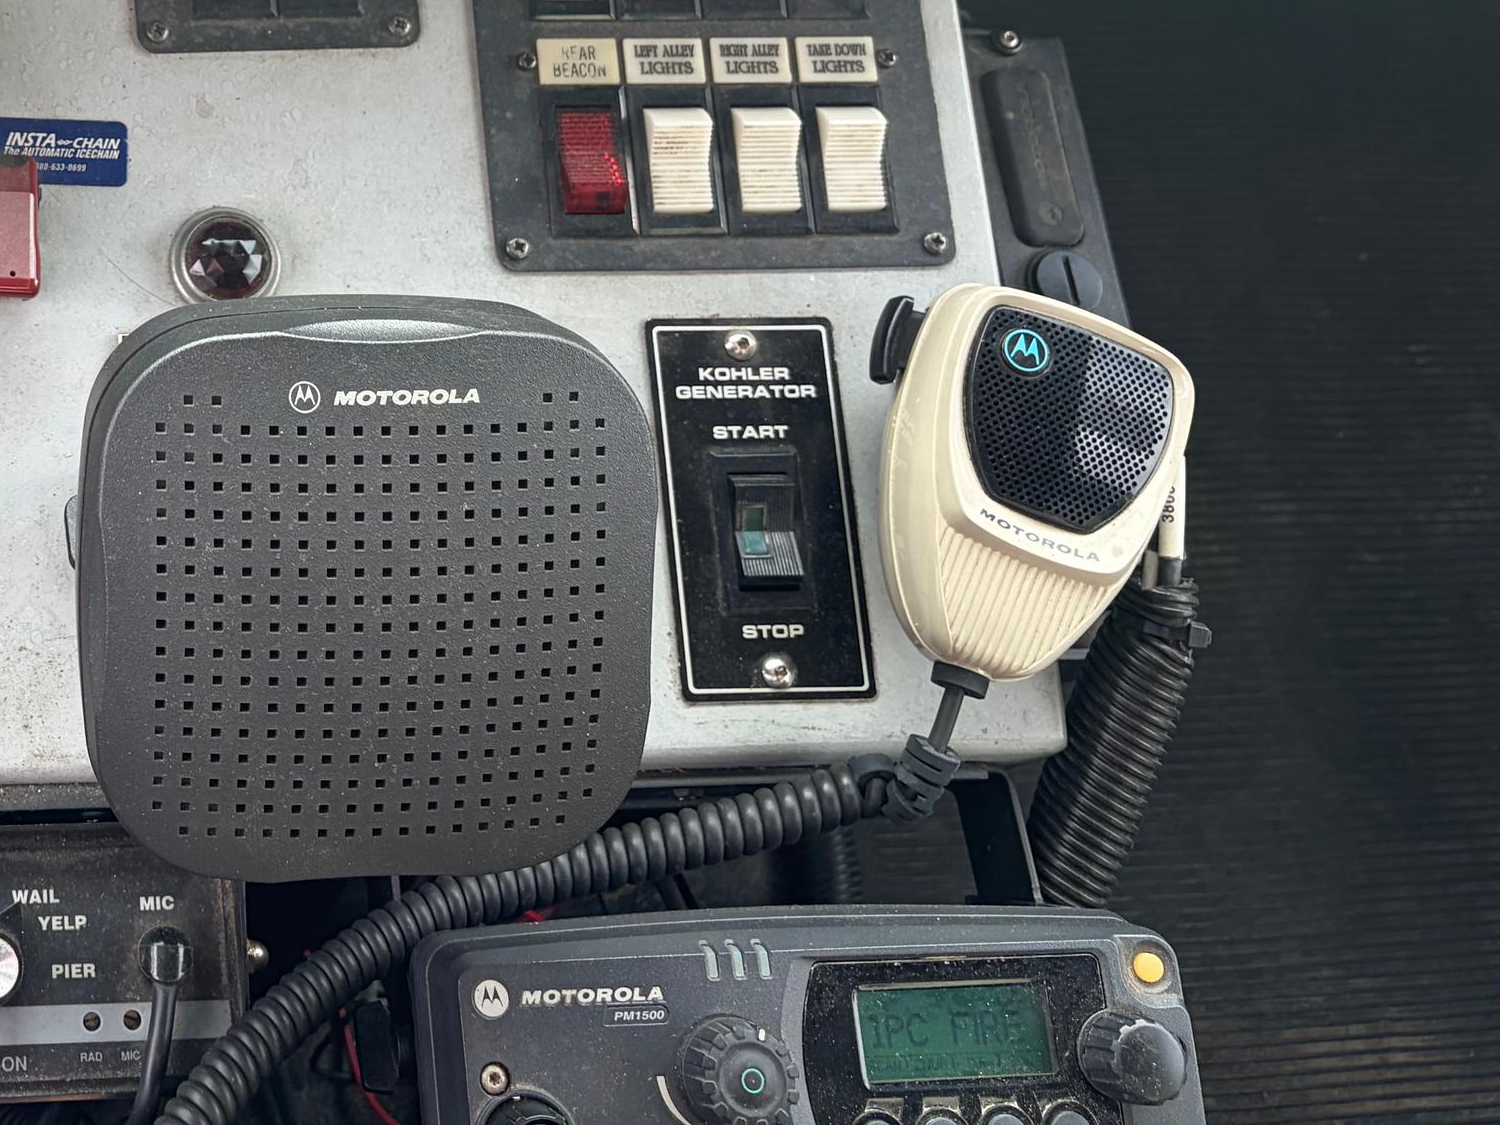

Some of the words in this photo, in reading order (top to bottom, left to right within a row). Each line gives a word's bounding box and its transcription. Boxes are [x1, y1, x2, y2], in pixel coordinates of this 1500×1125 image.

[634, 44, 659, 58] LEFT
[662, 44, 695, 58] ALLEY
[719, 43, 748, 57] RIGHT
[752, 43, 780, 57] ALLEY
[806, 43, 832, 56] TAKE
[834, 43, 867, 56] DOWN
[639, 61, 694, 75] LIGHTS
[725, 60, 779, 74] LIGHTS
[812, 60, 865, 74] LIGHTS
[5, 131, 56, 148] INSTA
[72, 137, 121, 150] CHAIN
[3, 147, 20, 156] The
[21, 147, 74, 158] AUTOMATIC
[75, 148, 120, 160] ICECHAIN
[698, 367, 789, 381] KOHLER
[333, 388, 481, 406] MOTOROLA
[675, 384, 817, 400] GENERATOR
[712, 425, 788, 439] START
[979, 507, 1101, 563] MOTOROLA
[742, 625, 804, 639] STOP
[12, 889, 60, 905] WAIL
[139, 895, 175, 911] MIC
[38, 915, 87, 931] YELP
[51, 963, 96, 979] PIER
[521, 986, 665, 1005] MOTOROLA
[614, 1010, 665, 1022] PM1500
[949, 1009, 1025, 1046] FIRE
[80, 1052, 103, 1063] RAD
[121, 1050, 142, 1061] MIC
